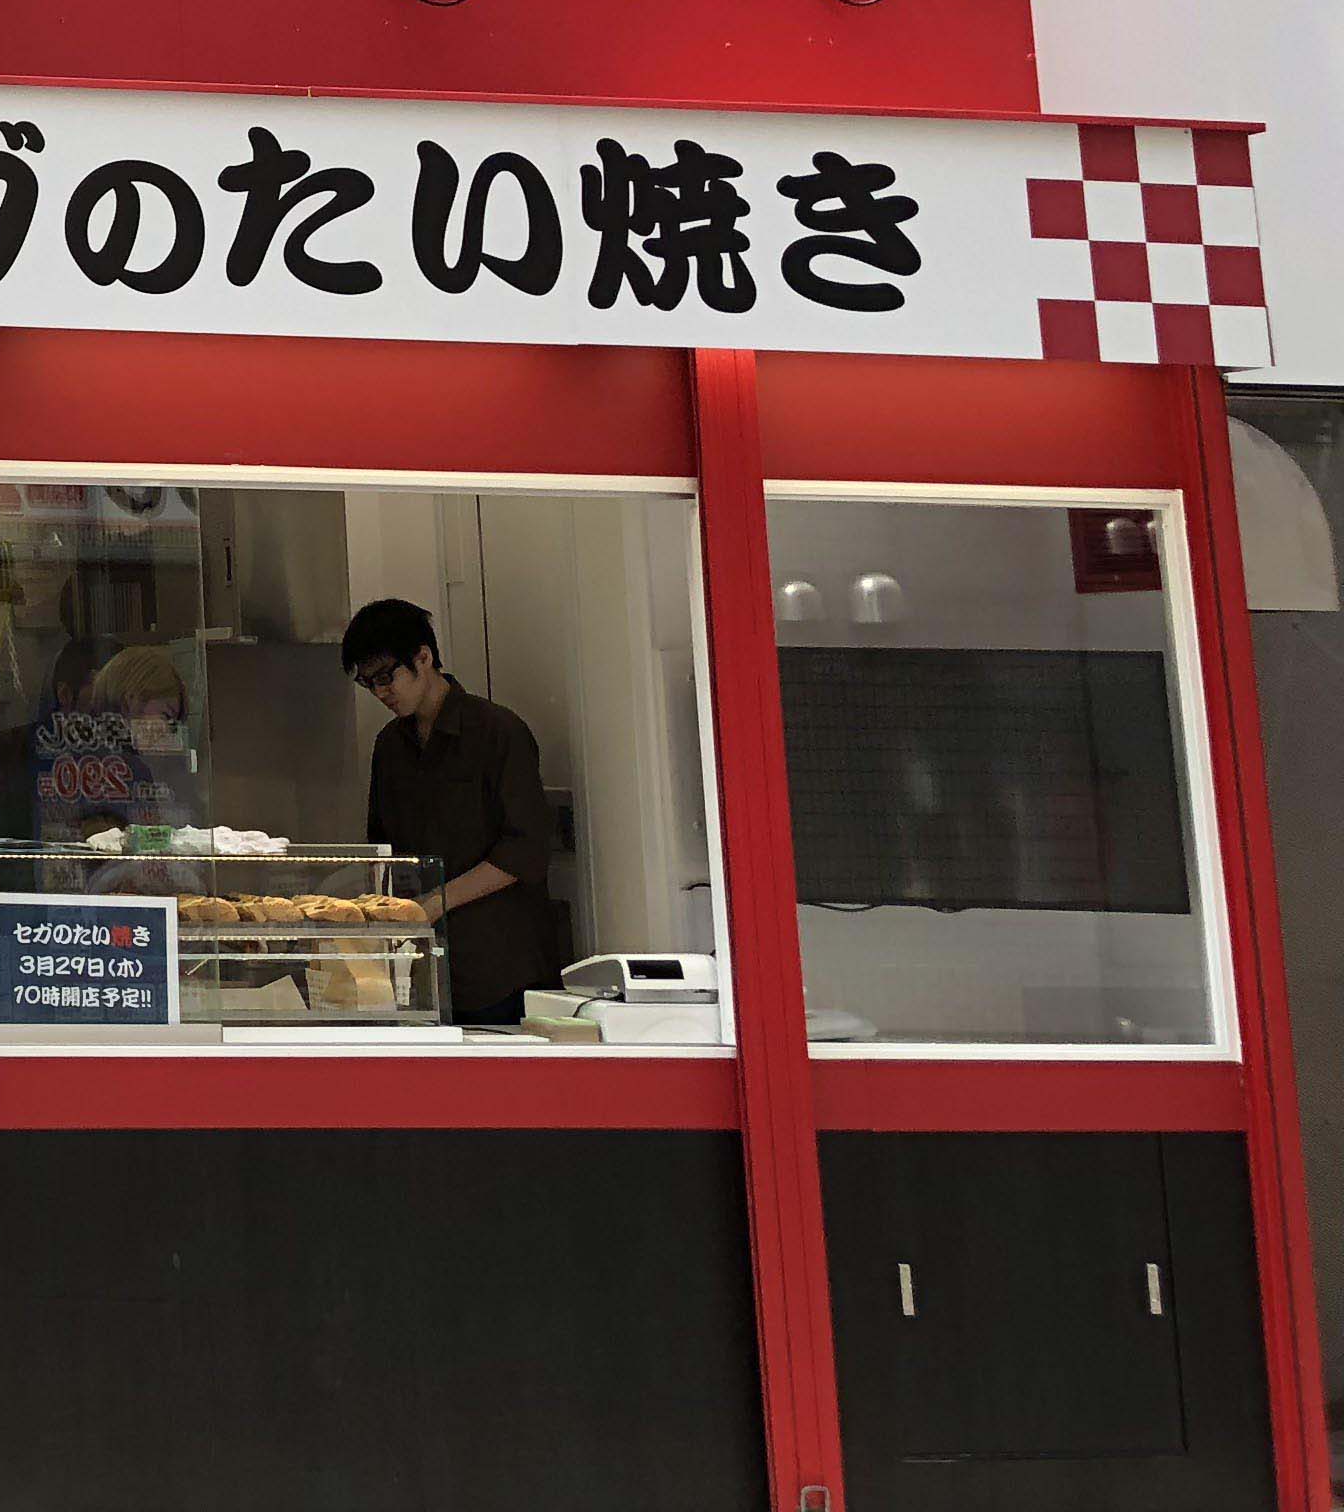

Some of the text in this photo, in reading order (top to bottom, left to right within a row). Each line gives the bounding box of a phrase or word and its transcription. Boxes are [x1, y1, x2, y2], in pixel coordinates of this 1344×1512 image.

[12, 922, 151, 949] セガのたい焼き
[13, 985, 152, 1009] 10時開店予定!!
